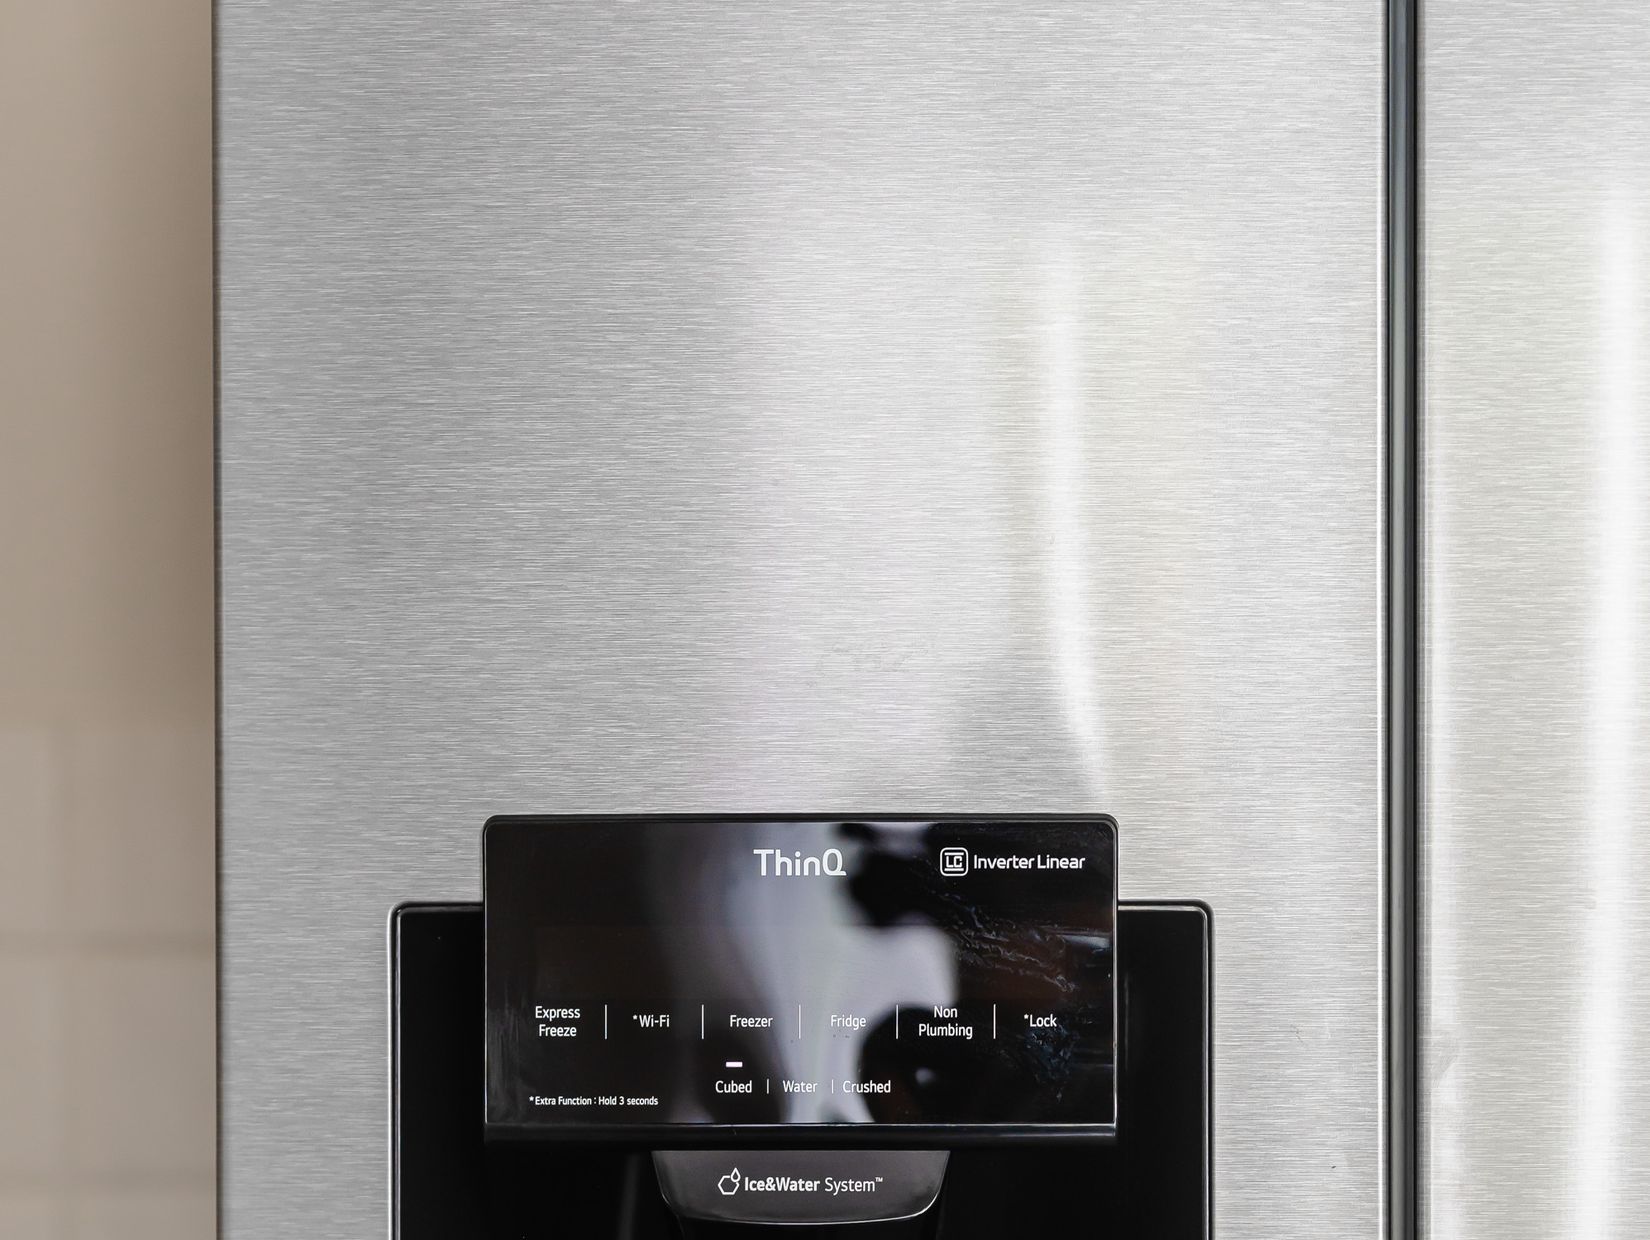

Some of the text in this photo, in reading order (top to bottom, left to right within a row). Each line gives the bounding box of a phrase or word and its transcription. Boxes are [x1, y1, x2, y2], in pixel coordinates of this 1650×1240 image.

[753, 848, 847, 877] ThinQ
[973, 854, 1035, 870] Inverter
[1037, 854, 1085, 870] Linear
[535, 1005, 581, 1022] Express
[933, 1005, 958, 1018] Non
[729, 1014, 773, 1028] Freezer
[830, 1014, 866, 1031] Fridge
[538, 1023, 577, 1037] Freeze
[918, 1023, 973, 1040] Plumbing
[715, 1080, 752, 1094] Cubed
[782, 1080, 818, 1093] Water
[842, 1080, 891, 1094] Crushed
[558, 1095, 592, 1106] Function
[598, 1095, 617, 1106] Hold
[619, 1096, 625, 1106] 3
[626, 1095, 659, 1106] seconds
[744, 1176, 820, 1192] Ice&Water
